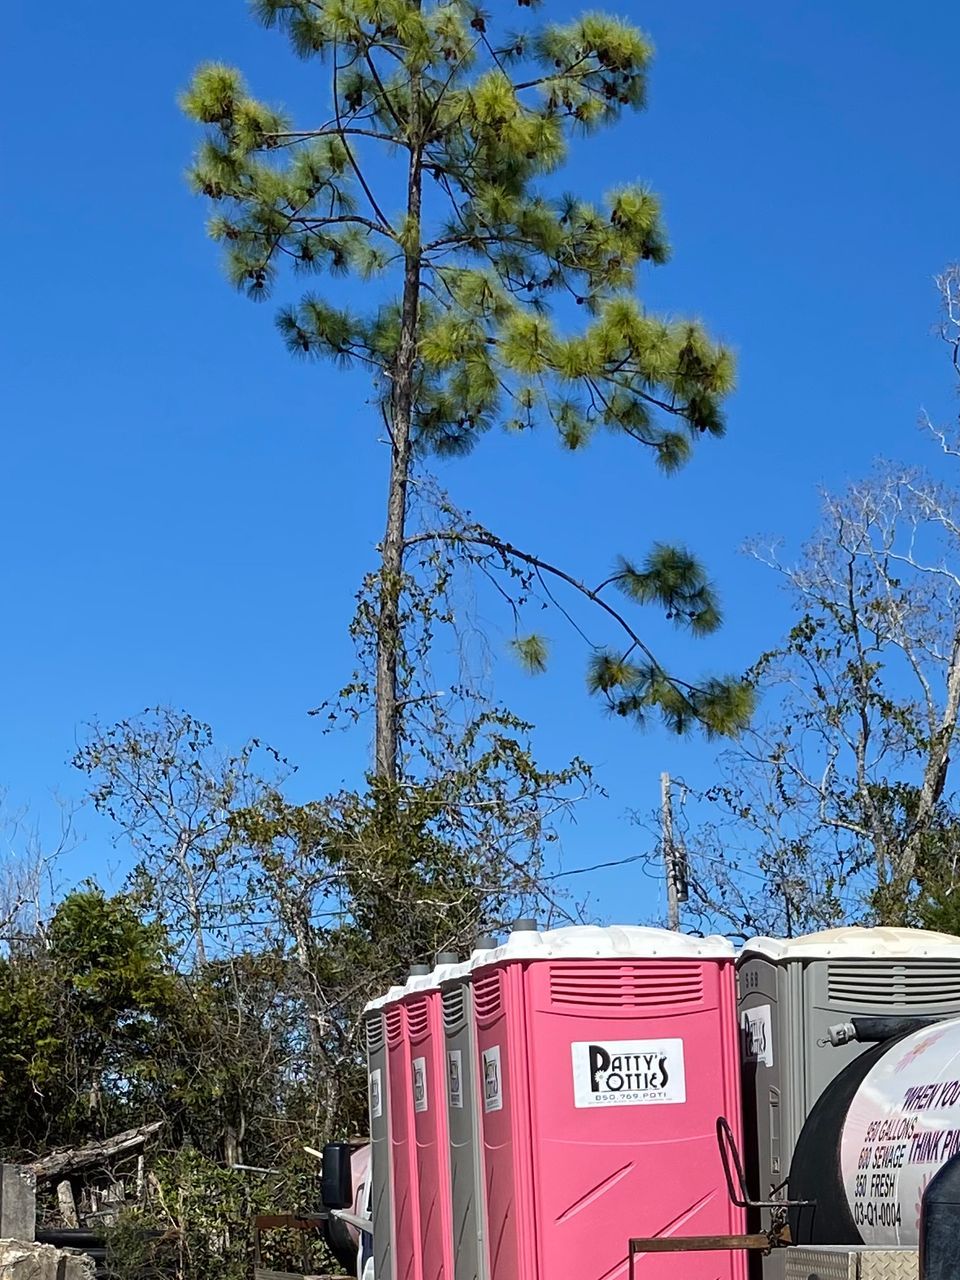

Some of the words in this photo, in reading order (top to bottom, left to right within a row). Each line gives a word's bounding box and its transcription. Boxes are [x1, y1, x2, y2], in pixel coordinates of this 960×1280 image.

[589, 1045, 668, 1073] PATTY'S
[880, 1117, 918, 1142] GALLONS
[858, 1147, 872, 1170] 600
[872, 1144, 907, 1169] SEWAGE
[908, 1130, 944, 1162] THINK
[855, 1173, 867, 1197] 350
[870, 1173, 895, 1198] FRESH
[854, 1202, 901, 1227] 03-Q1-0004
